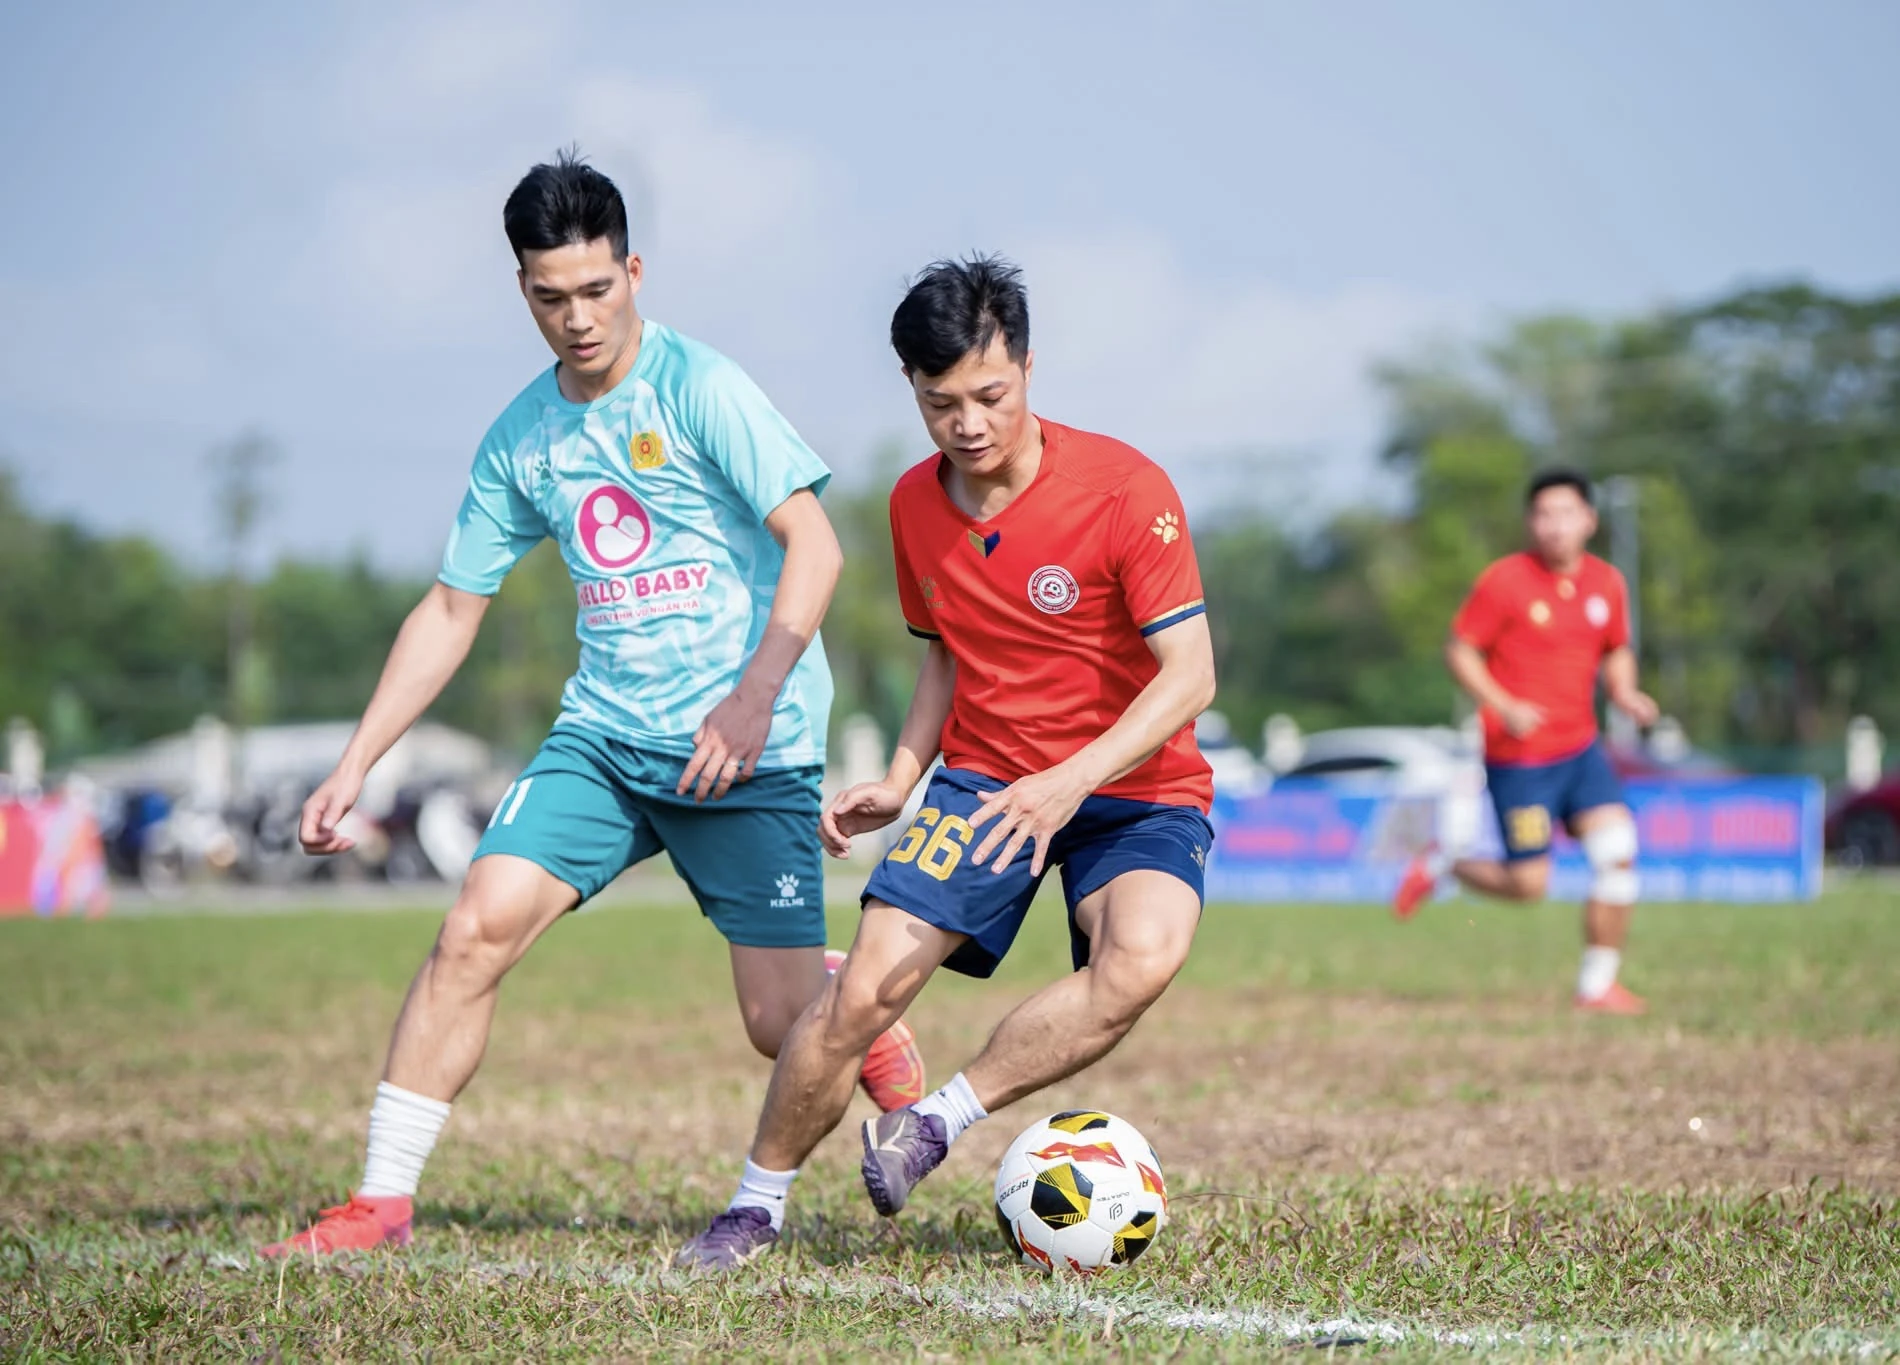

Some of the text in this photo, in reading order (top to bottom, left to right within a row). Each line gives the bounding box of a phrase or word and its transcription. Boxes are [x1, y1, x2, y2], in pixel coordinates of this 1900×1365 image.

[635, 565, 708, 598] BABY
[887, 806, 975, 882] 66
[770, 897, 805, 908] KELME
